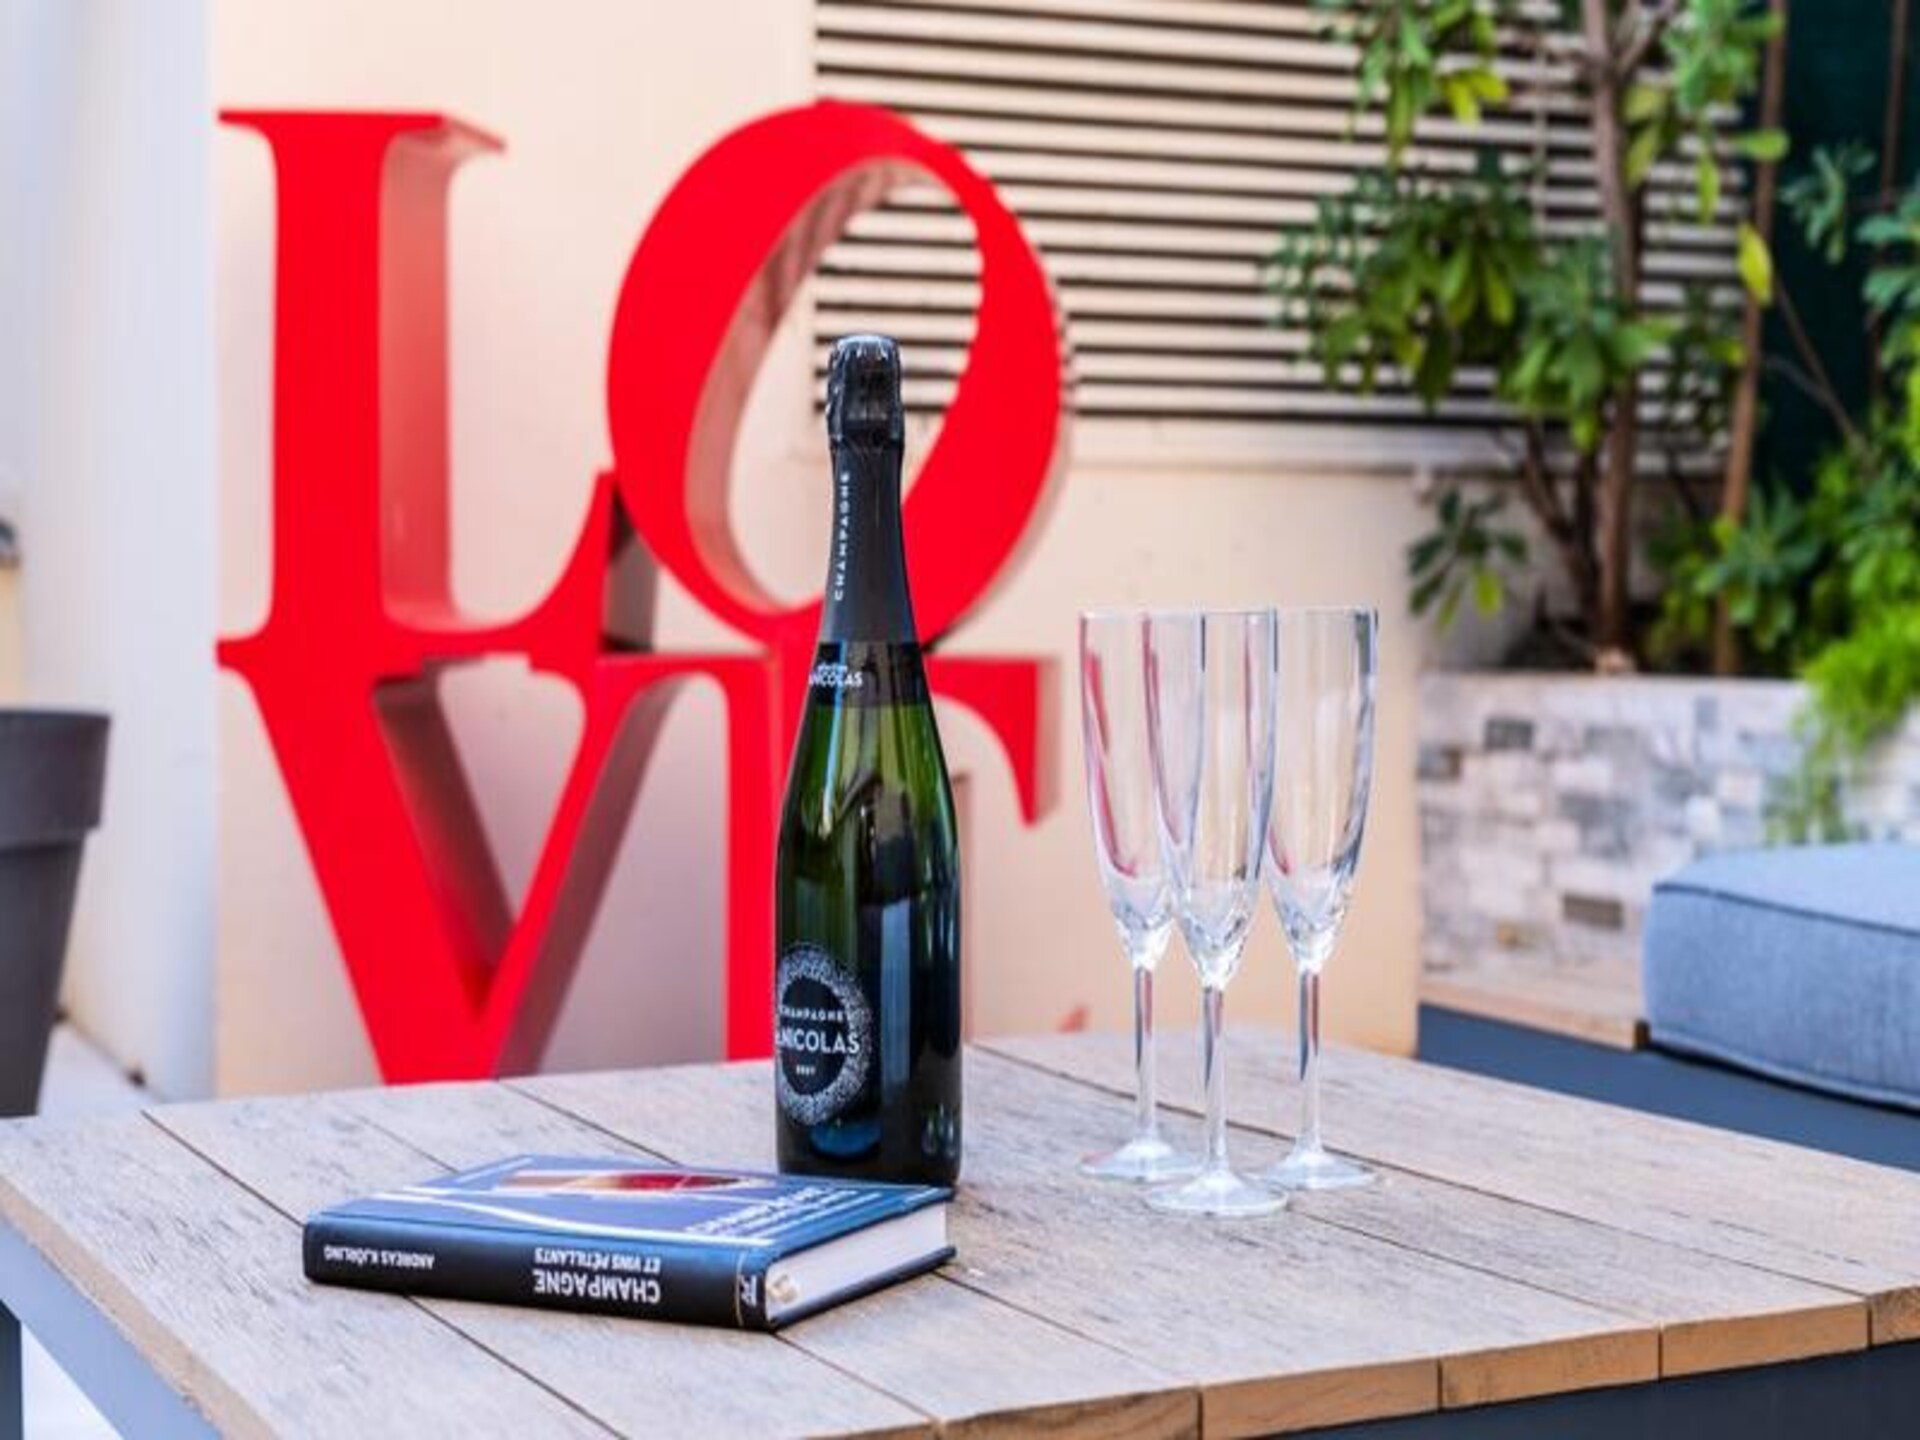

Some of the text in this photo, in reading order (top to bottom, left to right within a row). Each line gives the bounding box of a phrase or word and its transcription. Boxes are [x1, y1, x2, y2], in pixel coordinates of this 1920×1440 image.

[834, 472, 851, 601] CHAMPAGNE
[380, 1250, 435, 1270] ANDREAS
[611, 1253, 643, 1273] VINS
[645, 1257, 662, 1274] ET
[533, 1269, 662, 1304] CHAMPAGNE
